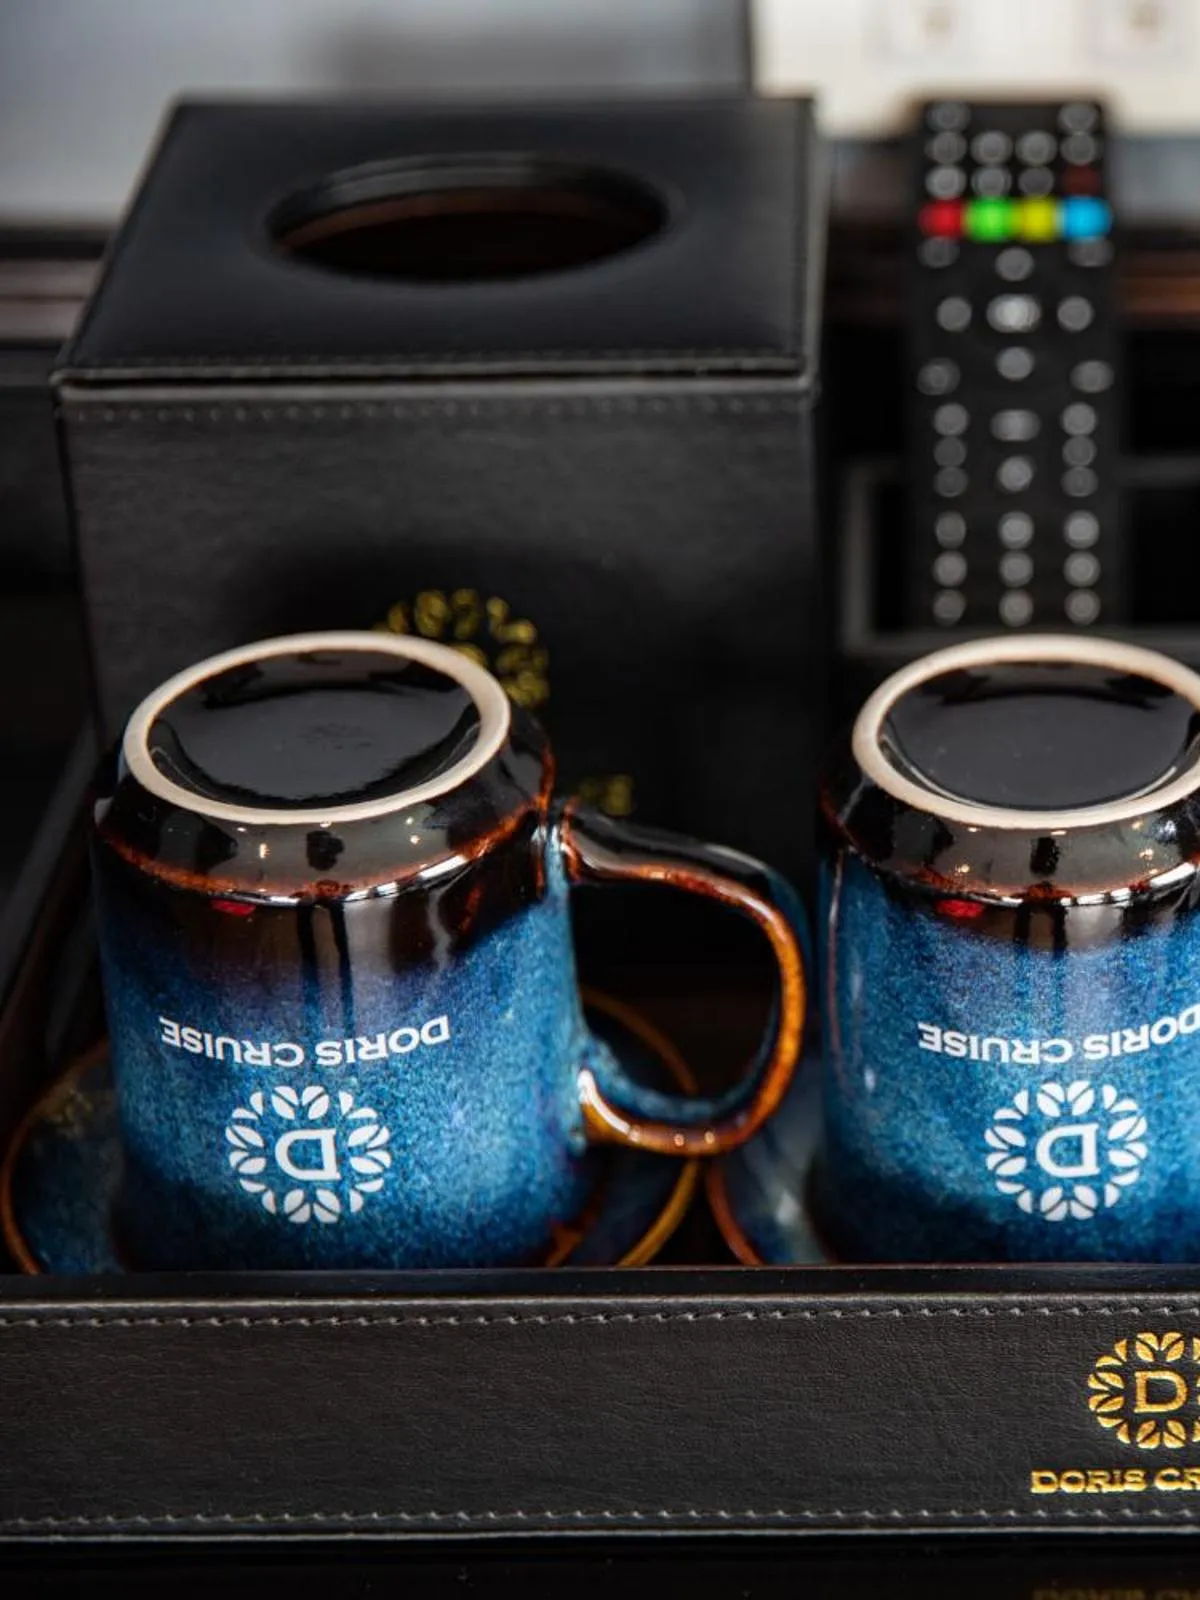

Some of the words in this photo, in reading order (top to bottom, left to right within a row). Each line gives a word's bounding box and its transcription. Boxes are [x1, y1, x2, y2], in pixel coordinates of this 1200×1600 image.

[158, 1016, 305, 1067] CRUISE
[315, 1015, 450, 1066] DORIS
[917, 1021, 1074, 1065] CRUISE
[1133, 1370, 1189, 1413] D
[1030, 1468, 1148, 1494] DORIS
